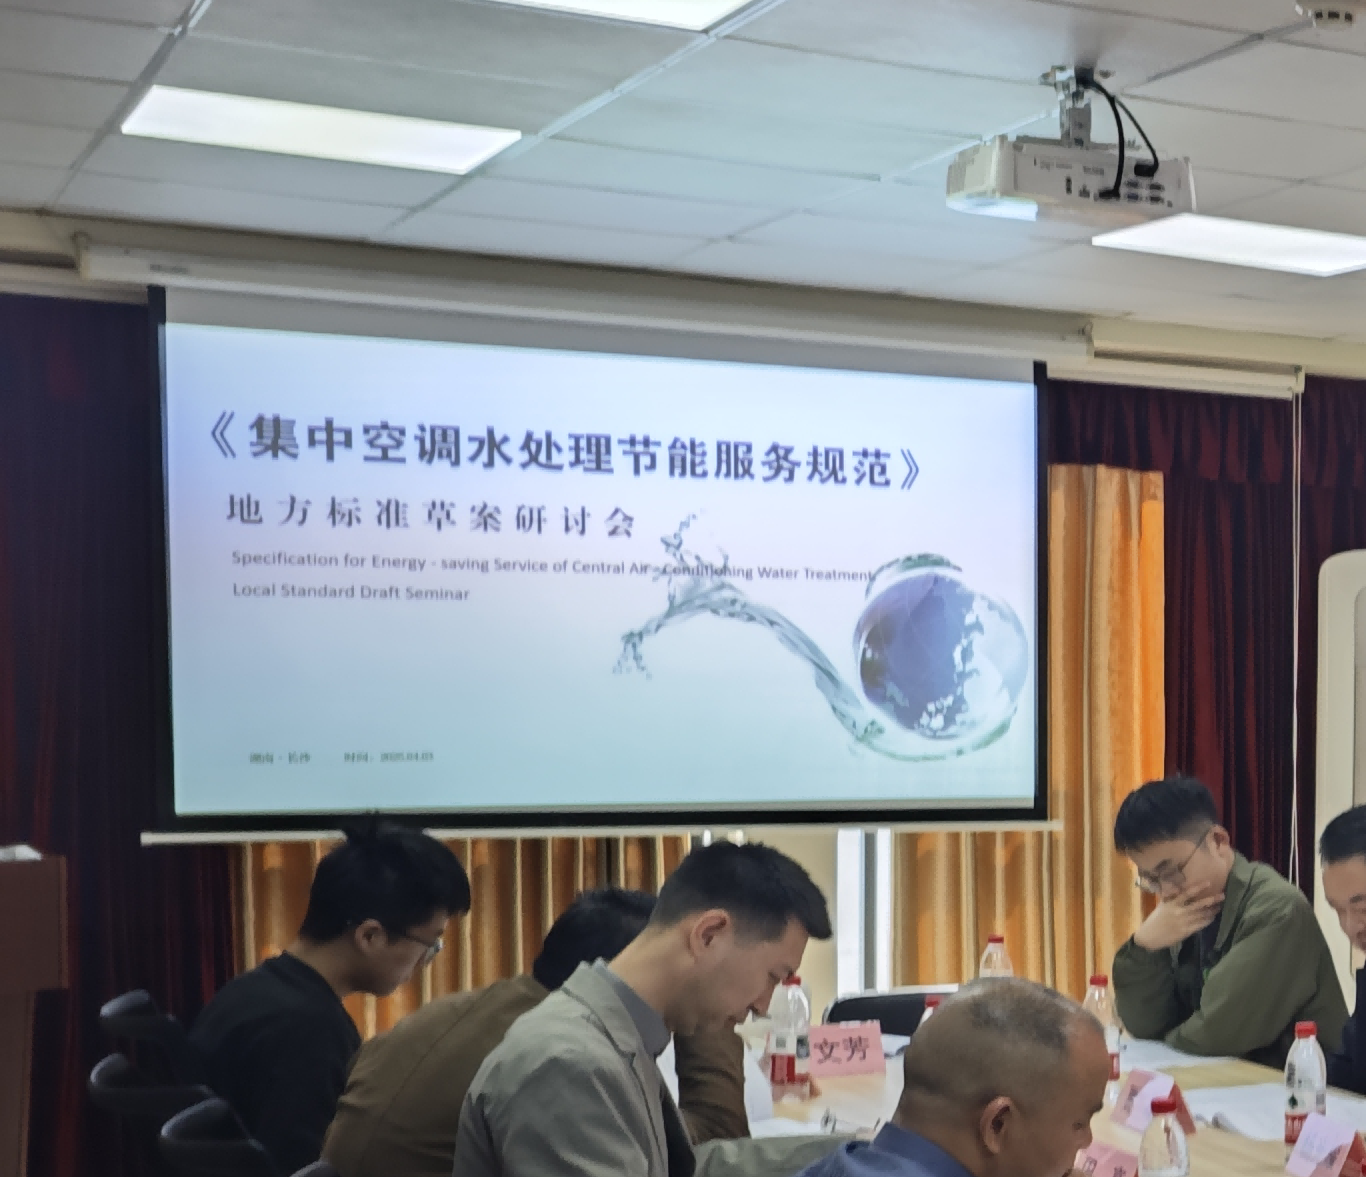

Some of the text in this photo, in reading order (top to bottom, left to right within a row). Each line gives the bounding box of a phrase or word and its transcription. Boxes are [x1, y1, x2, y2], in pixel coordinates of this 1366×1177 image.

[210, 409, 920, 490] 《集中空调水处理节能服务规范》
[226, 492, 634, 538] 地方标准草案研讨会
[232, 550, 339, 568] Specification
[344, 551, 367, 568] for
[372, 554, 426, 572] Energy
[441, 556, 489, 574] saving
[495, 556, 548, 573] Service
[553, 559, 568, 574] of
[573, 560, 625, 575] Central
[629, 562, 649, 575] Air
[758, 566, 799, 580] Water
[804, 568, 875, 583] Treatment
[233, 583, 470, 601] Local Standard Draft Seminar
